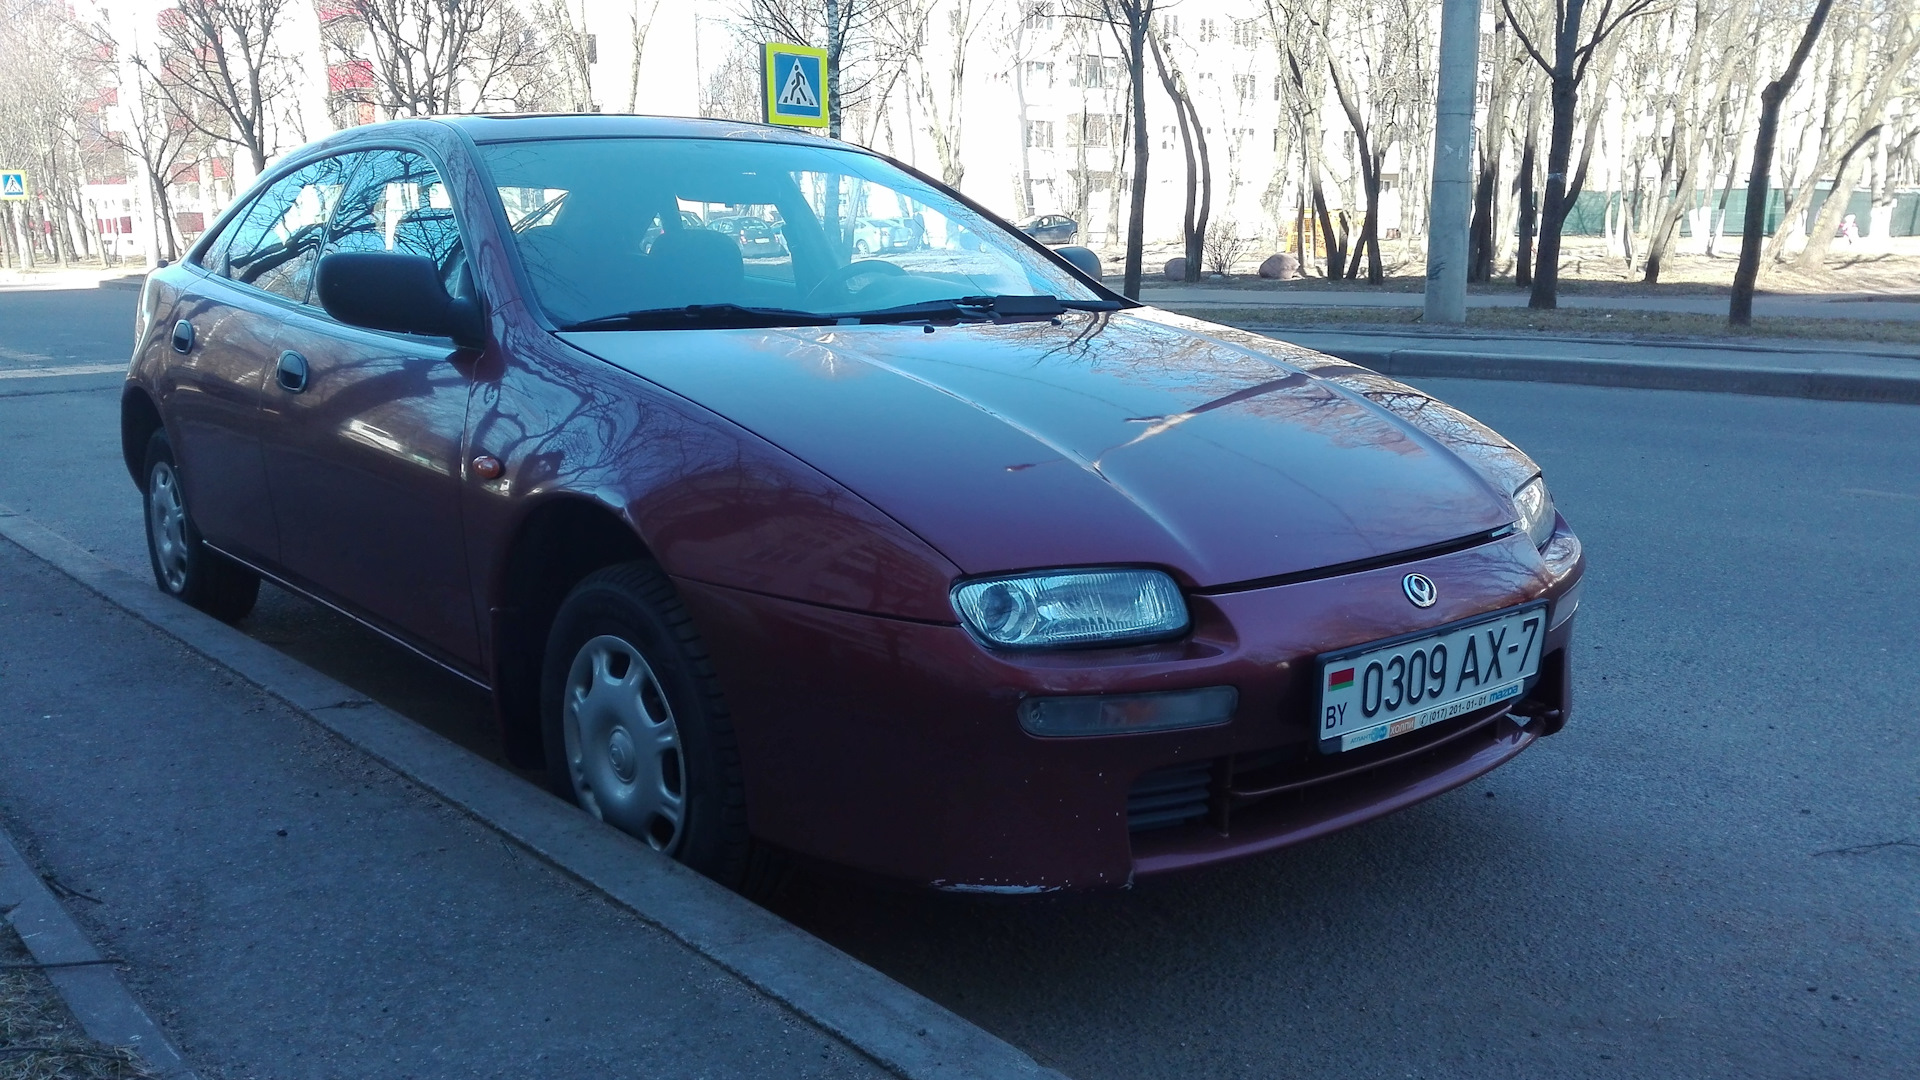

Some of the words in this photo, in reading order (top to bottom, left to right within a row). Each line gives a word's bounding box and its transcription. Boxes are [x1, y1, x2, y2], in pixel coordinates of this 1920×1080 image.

[1361, 643, 1448, 718] 0309
[1456, 618, 1540, 692] AX-7
[1489, 685, 1518, 702] mazda
[1325, 702, 1348, 730] BY
[1429, 708, 1447, 721] (017)
[1390, 720, 1415, 735] ХОЛПИ
